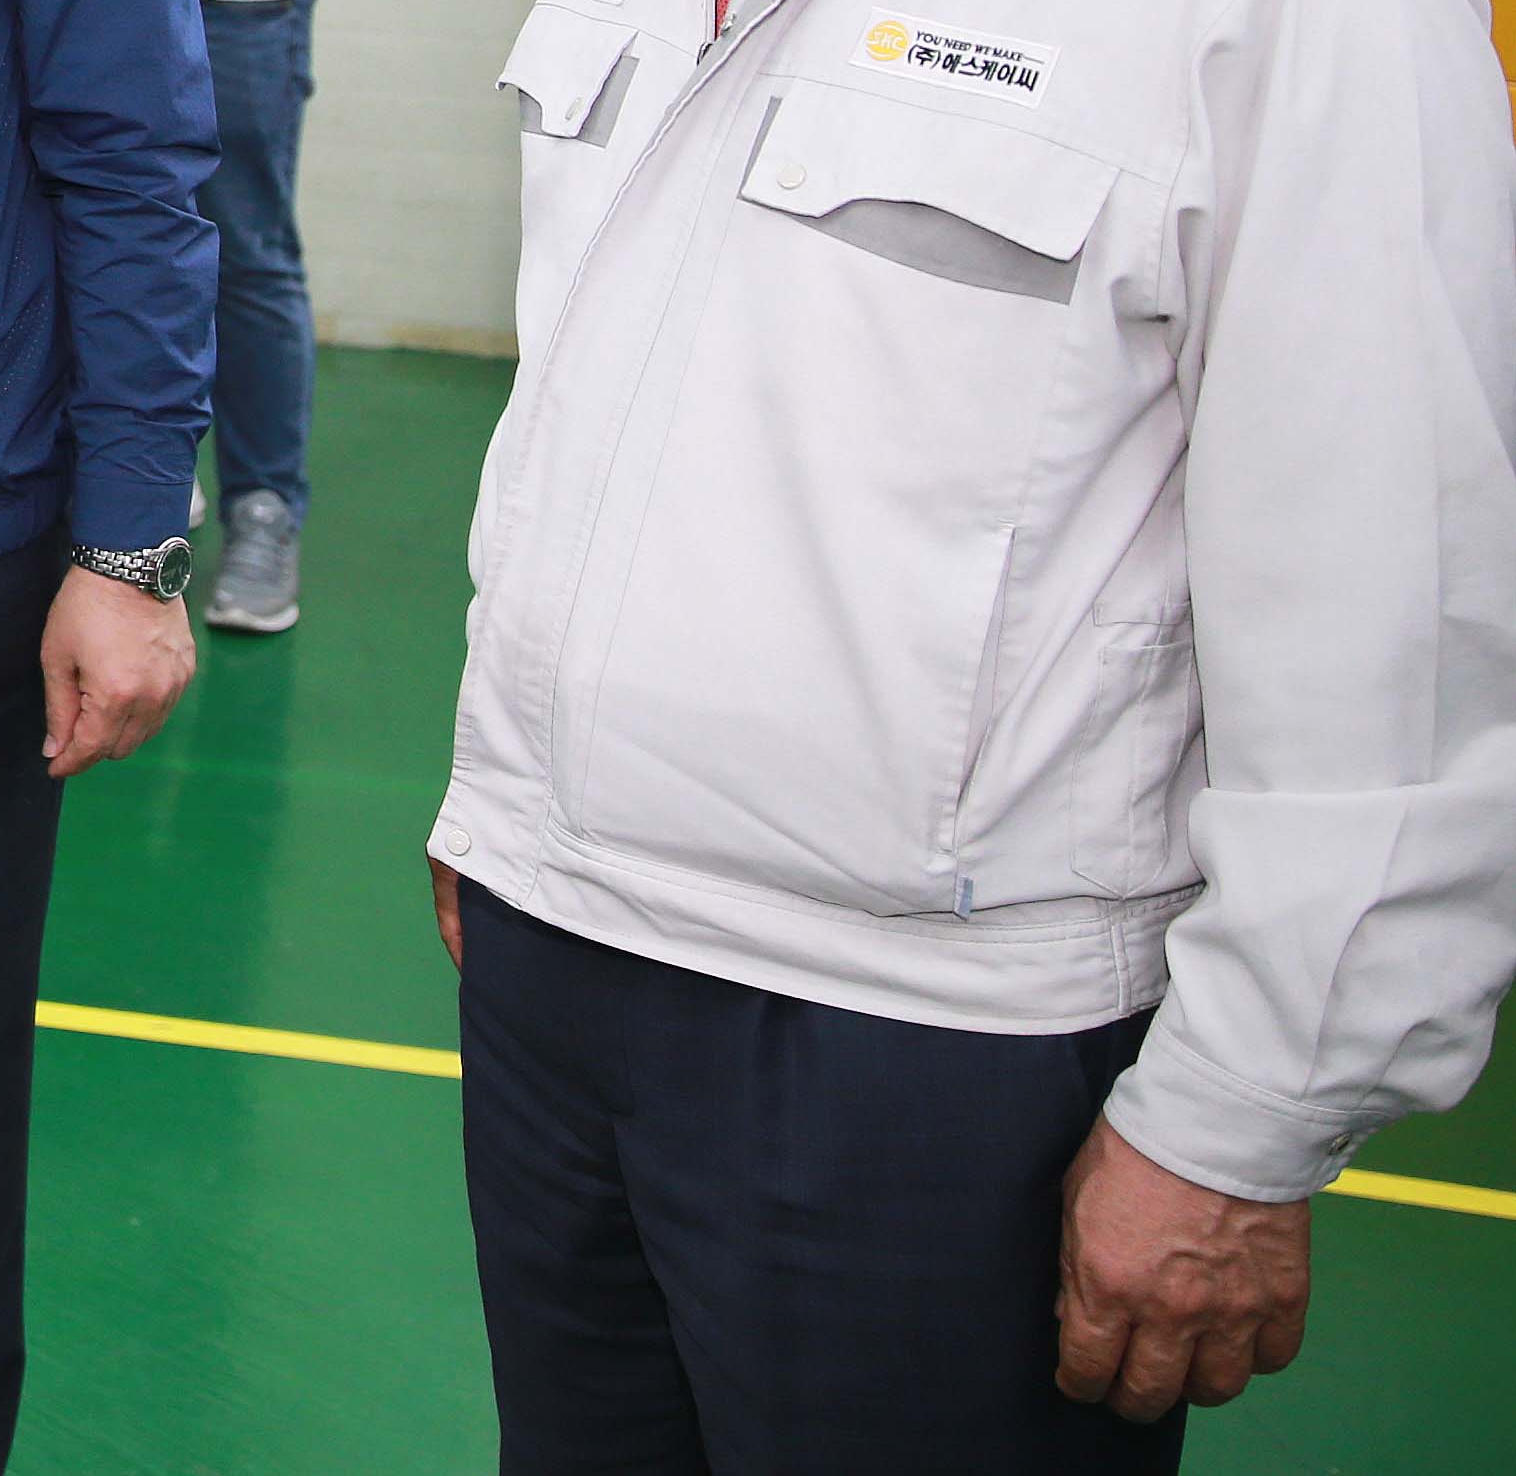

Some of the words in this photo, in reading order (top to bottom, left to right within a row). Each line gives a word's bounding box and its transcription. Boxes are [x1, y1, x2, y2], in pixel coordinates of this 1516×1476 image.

[917, 30, 943, 46] YOU
[943, 37, 972, 52] NEED
[975, 44, 991, 56] WE
[991, 47, 1024, 62] MAKE
[907, 44, 1040, 92] (주)에스케이씨
